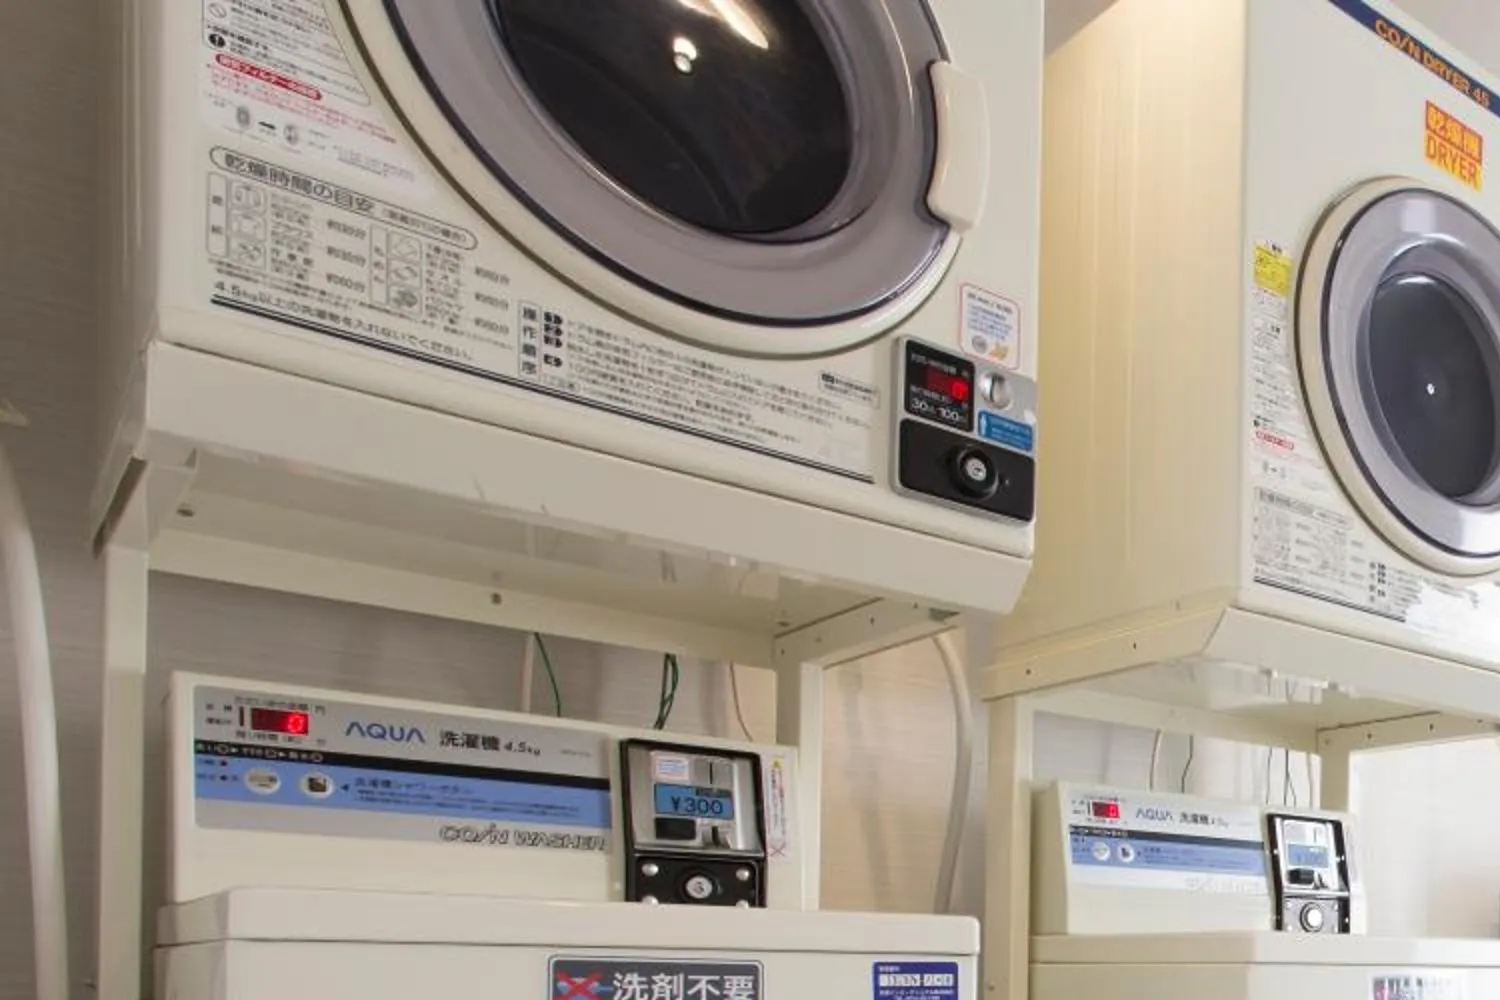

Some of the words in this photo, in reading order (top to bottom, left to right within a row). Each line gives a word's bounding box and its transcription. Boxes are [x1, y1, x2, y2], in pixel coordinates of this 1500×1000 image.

[1423, 49, 1471, 95] DRYER
[1426, 133, 1479, 188] DRYER
[346, 721, 425, 743] AQUA
[440, 730, 499, 751] 洗濯機
[671, 795, 723, 814] ¥300
[1135, 807, 1173, 821] AQUA
[514, 829, 606, 851] WASHER
